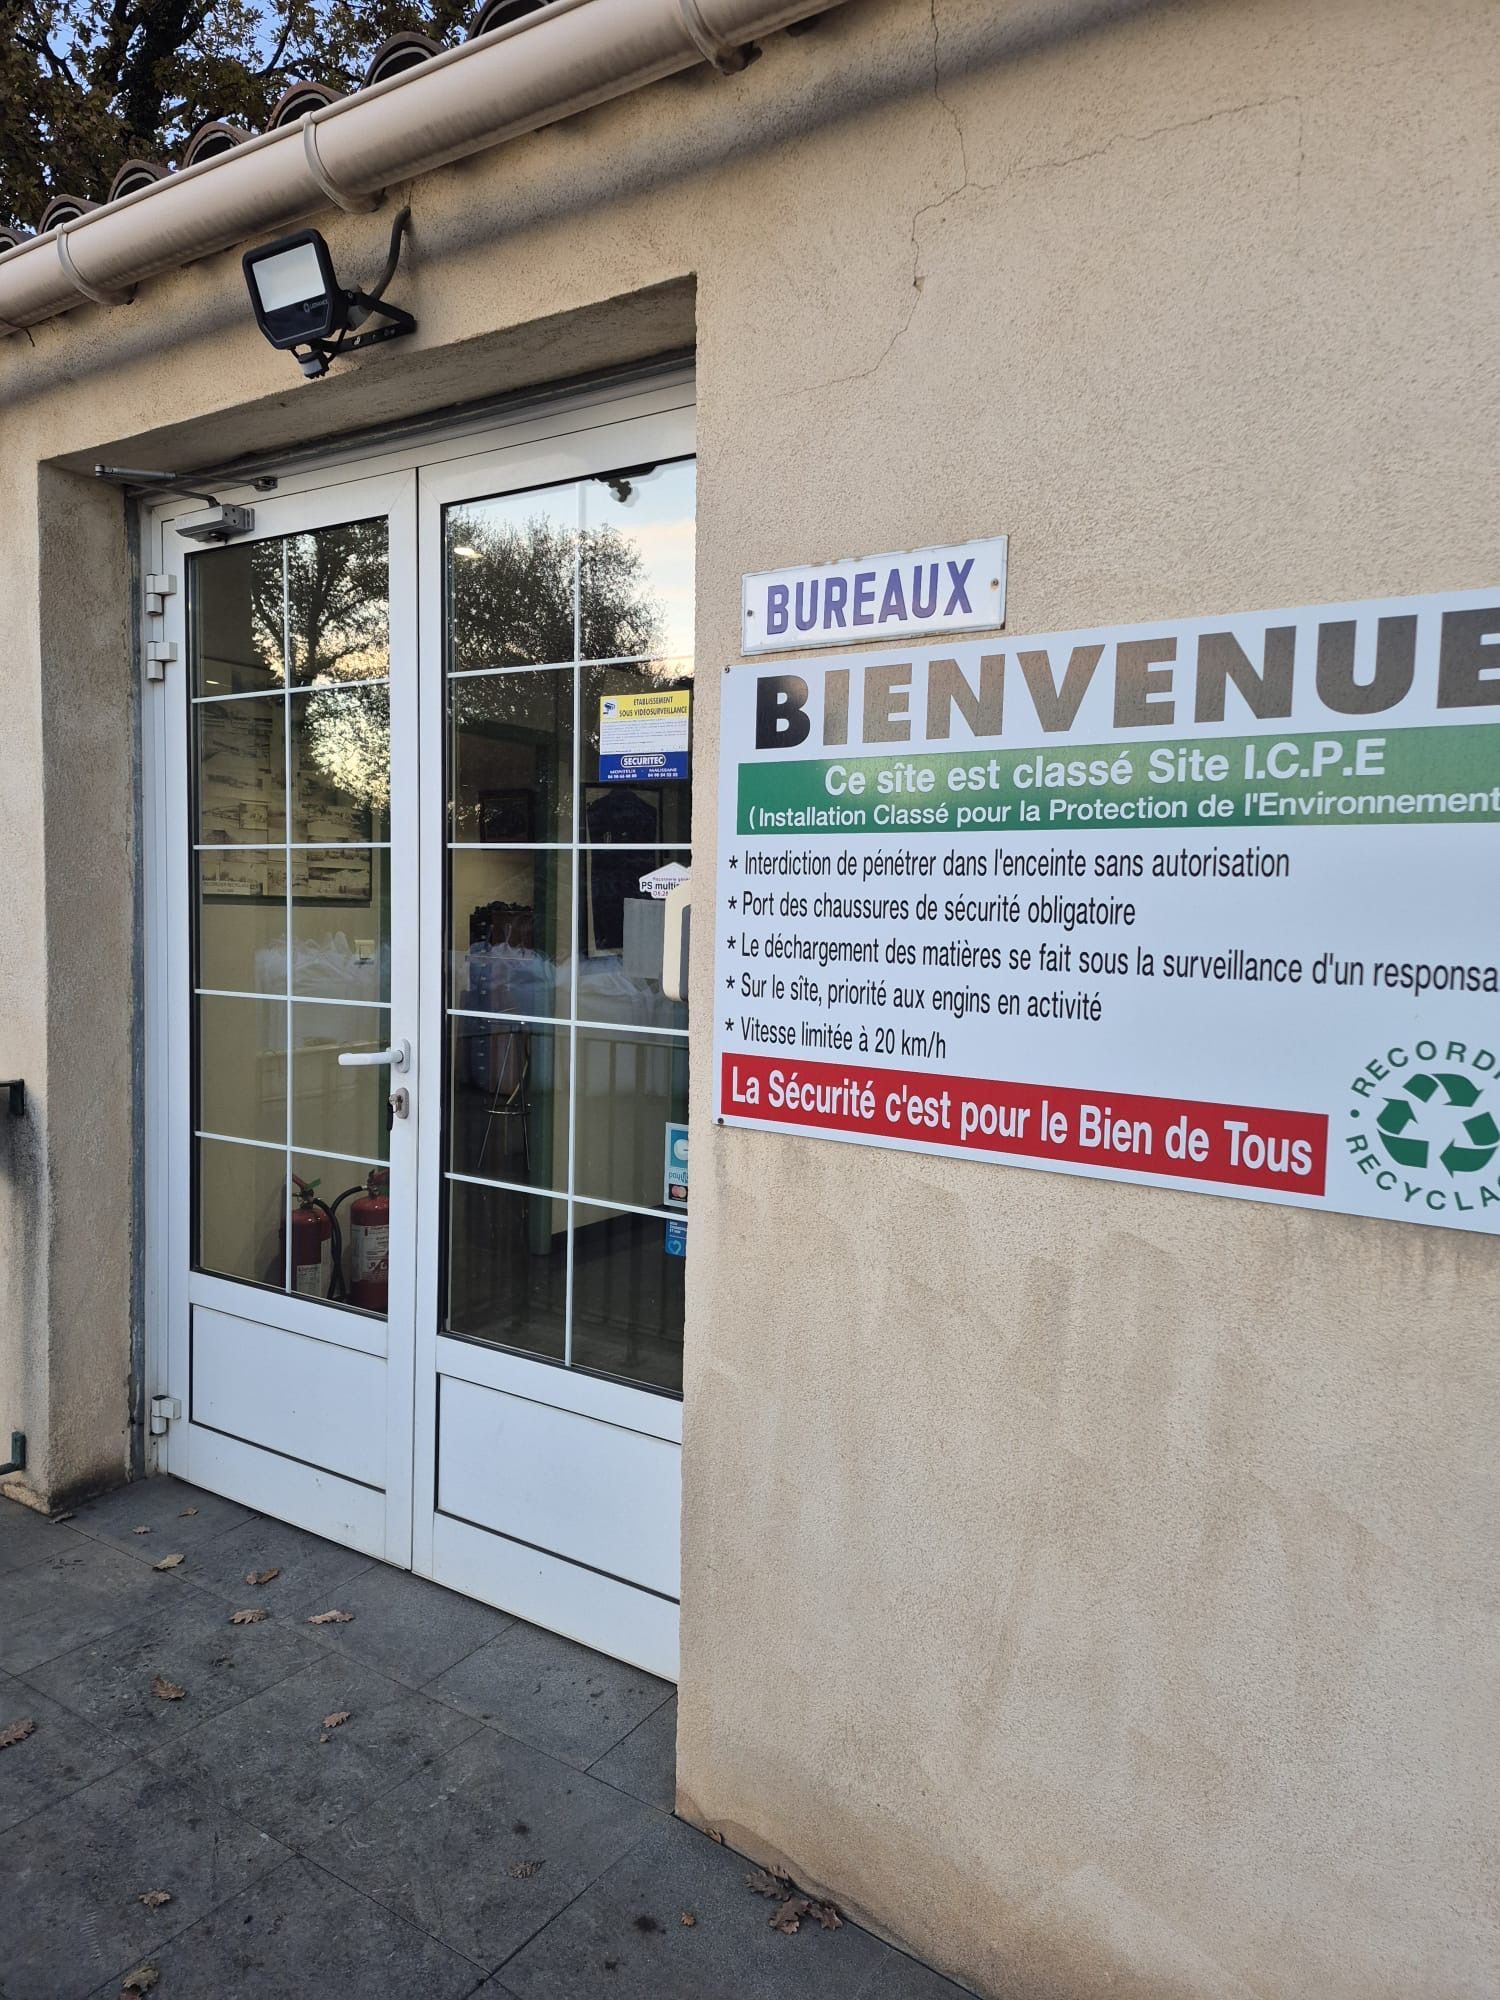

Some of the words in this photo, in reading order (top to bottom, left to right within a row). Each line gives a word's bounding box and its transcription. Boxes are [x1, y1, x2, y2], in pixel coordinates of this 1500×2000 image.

[766, 558, 975, 636] BUREAUX
[633, 696, 673, 706] ETABLISSEMENT
[755, 607, 1500, 750] BIENVENUE
[619, 709, 633, 718] SOUS
[634, 706, 688, 717] VIDEOSURVEILLANCE
[623, 757, 664, 766] SECURITEC
[825, 764, 866, 796] Ce
[877, 763, 935, 794] sîte
[947, 759, 1000, 791] est
[1012, 751, 1133, 789] classé
[1148, 747, 1230, 784] Site
[1244, 738, 1387, 780] I.C.P.E
[873, 801, 949, 826] Classé
[956, 804, 1012, 828] pour
[1019, 800, 1041, 822] la
[1049, 797, 1188, 821] Protection
[1197, 794, 1235, 818] de
[1244, 787, 1500, 818] l'Environnement
[641, 881, 653, 890] PS
[744, 850, 831, 876] Interdiction
[836, 850, 857, 876] de
[863, 849, 936, 882] pénétrer
[943, 849, 987, 877] dans
[994, 848, 1086, 877] l'enceinte
[1094, 854, 1144, 878] sans
[1152, 846, 1290, 878] autorisation
[743, 891, 774, 917] Port
[780, 892, 808, 918] des
[813, 892, 909, 920] chaussures
[915, 893, 938, 921] de
[944, 893, 1020, 923] sécurité
[1028, 895, 1136, 932] obligatoire
[741, 932, 759, 958] Le
[765, 933, 879, 967] déchargement
[885, 938, 916, 965] des
[922, 939, 1001, 969] matières
[1008, 949, 1031, 970] se
[1039, 943, 1071, 973] fait
[1078, 950, 1129, 975] sous
[1136, 946, 1155, 977] la
[1162, 949, 1303, 984] surveillance
[1312, 952, 1364, 986] d'un
[1373, 961, 1500, 997] responsa
[741, 972, 767, 998] Sur
[772, 974, 785, 999] le
[827, 978, 887, 1009] priorité
[893, 987, 925, 1009] aux
[932, 985, 990, 1019] engins
[997, 993, 1020, 1016] en
[1027, 990, 1102, 1022] activité
[741, 1016, 796, 1045] Vitesse
[801, 1021, 853, 1050] limitée
[858, 1026, 869, 1052] à
[875, 1027, 895, 1055] 20
[901, 1029, 947, 1059] km/h
[1350, 1040, 1500, 1098] RECORD
[732, 1066, 760, 1105] La
[768, 1069, 876, 1120] Sécurité
[885, 1084, 951, 1129] c'est
[960, 1101, 1031, 1141] pour
[1041, 1100, 1068, 1144] le
[1079, 1104, 1153, 1155] Bien
[1165, 1115, 1209, 1162] de
[1223, 1120, 1313, 1176] Tous
[1345, 1134, 1500, 1211] RECYCLA
